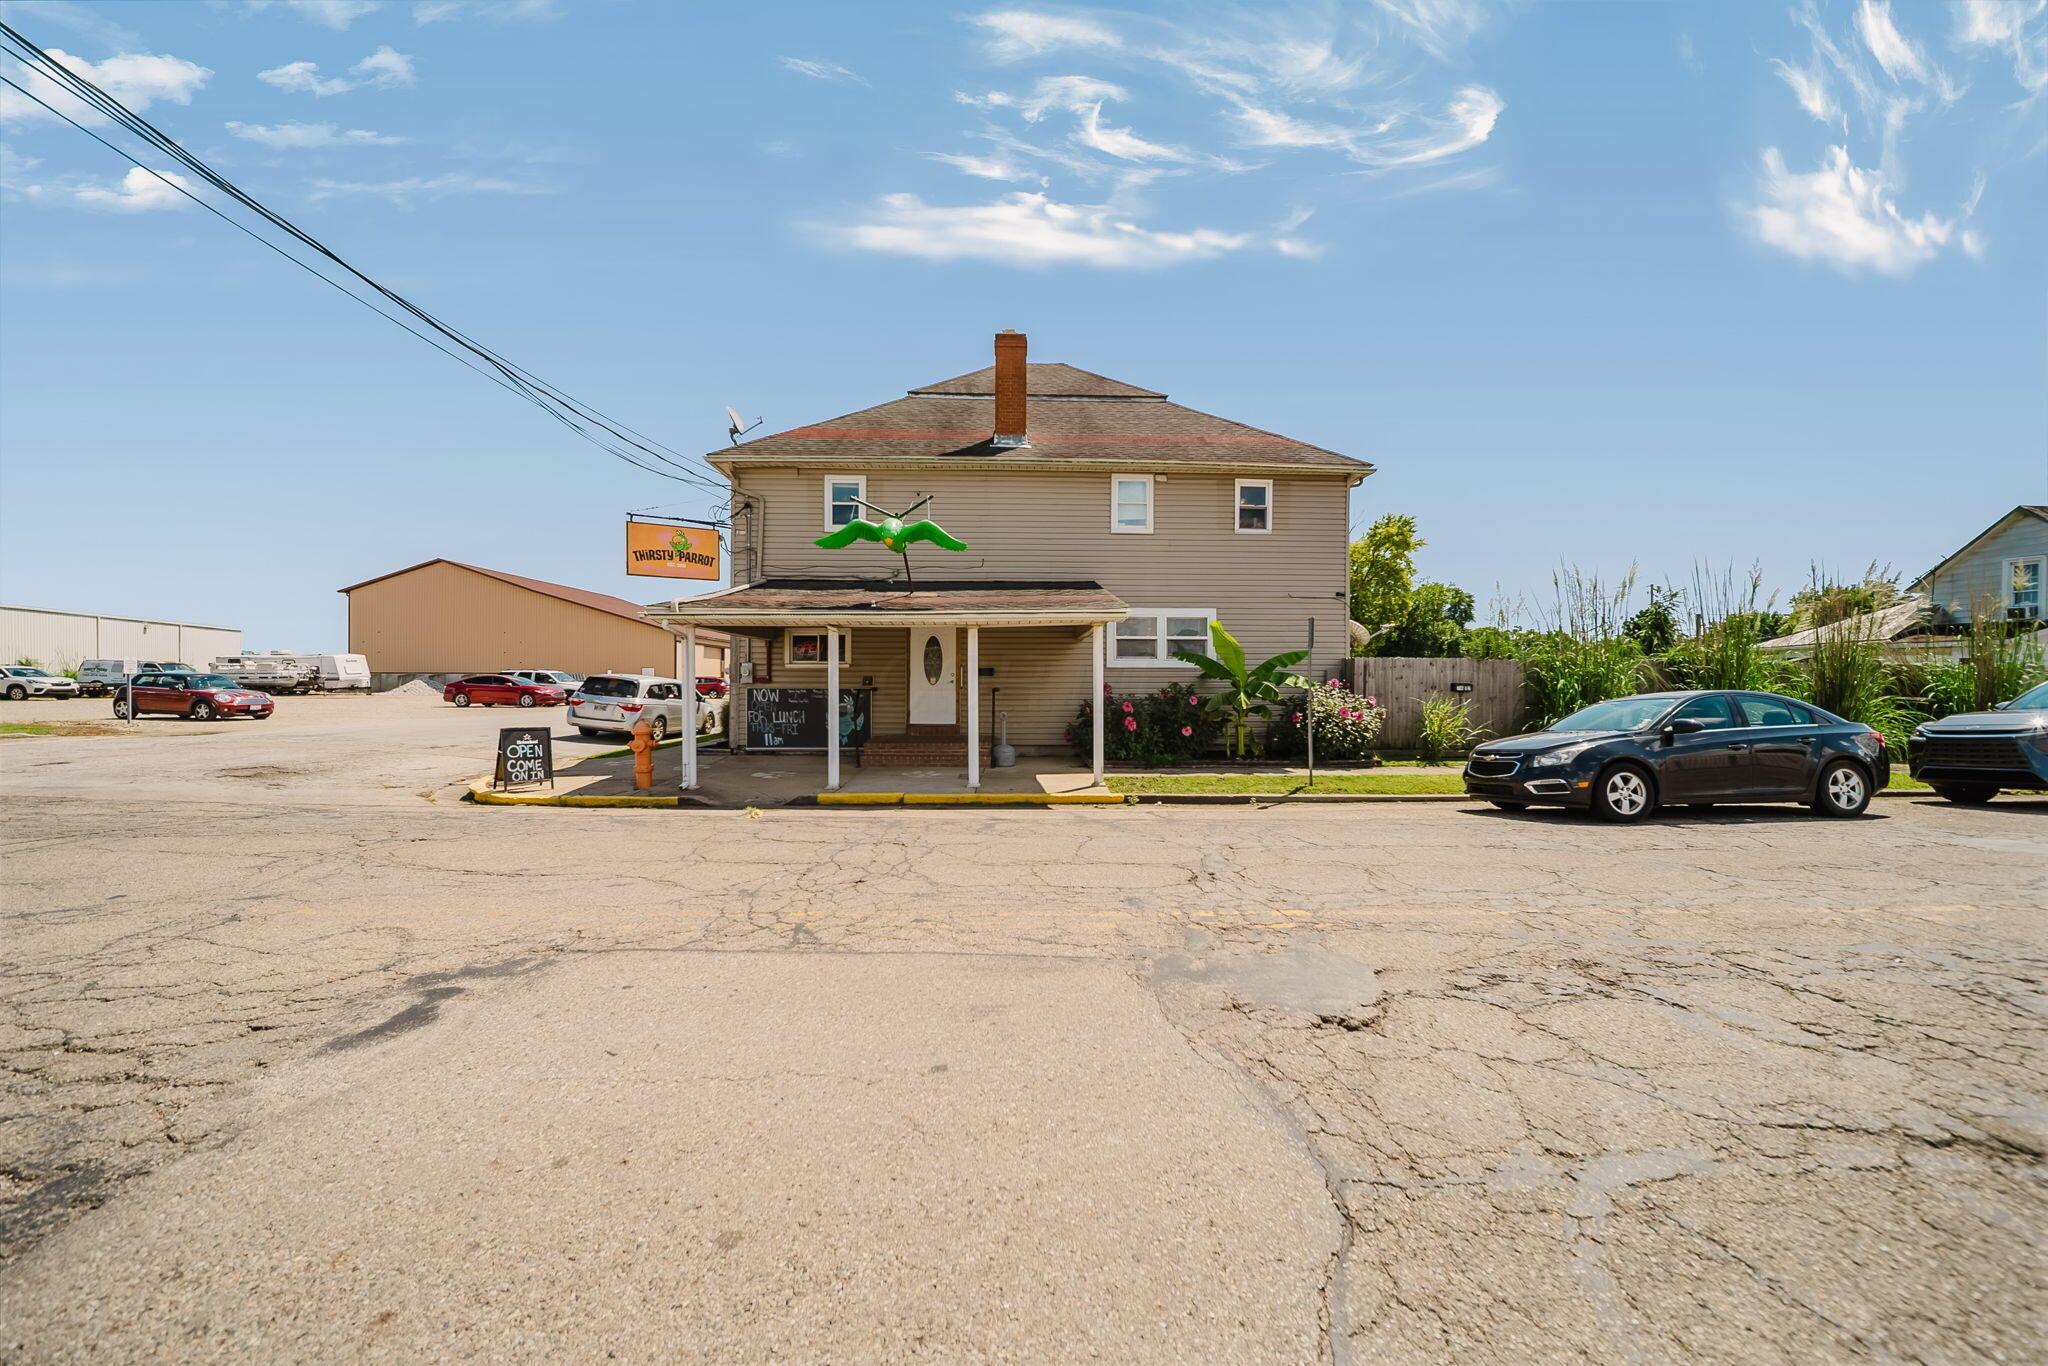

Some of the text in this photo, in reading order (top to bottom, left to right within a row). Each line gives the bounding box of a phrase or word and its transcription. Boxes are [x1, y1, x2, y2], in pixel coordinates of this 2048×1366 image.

[679, 551, 716, 567] PARROT
[753, 689, 779, 702] NOW
[751, 701, 777, 712] OPEN
[773, 710, 806, 724] LUNCH
[507, 745, 543, 758] OPEN
[507, 760, 542, 772] COME
[512, 770, 544, 781] ON IN
